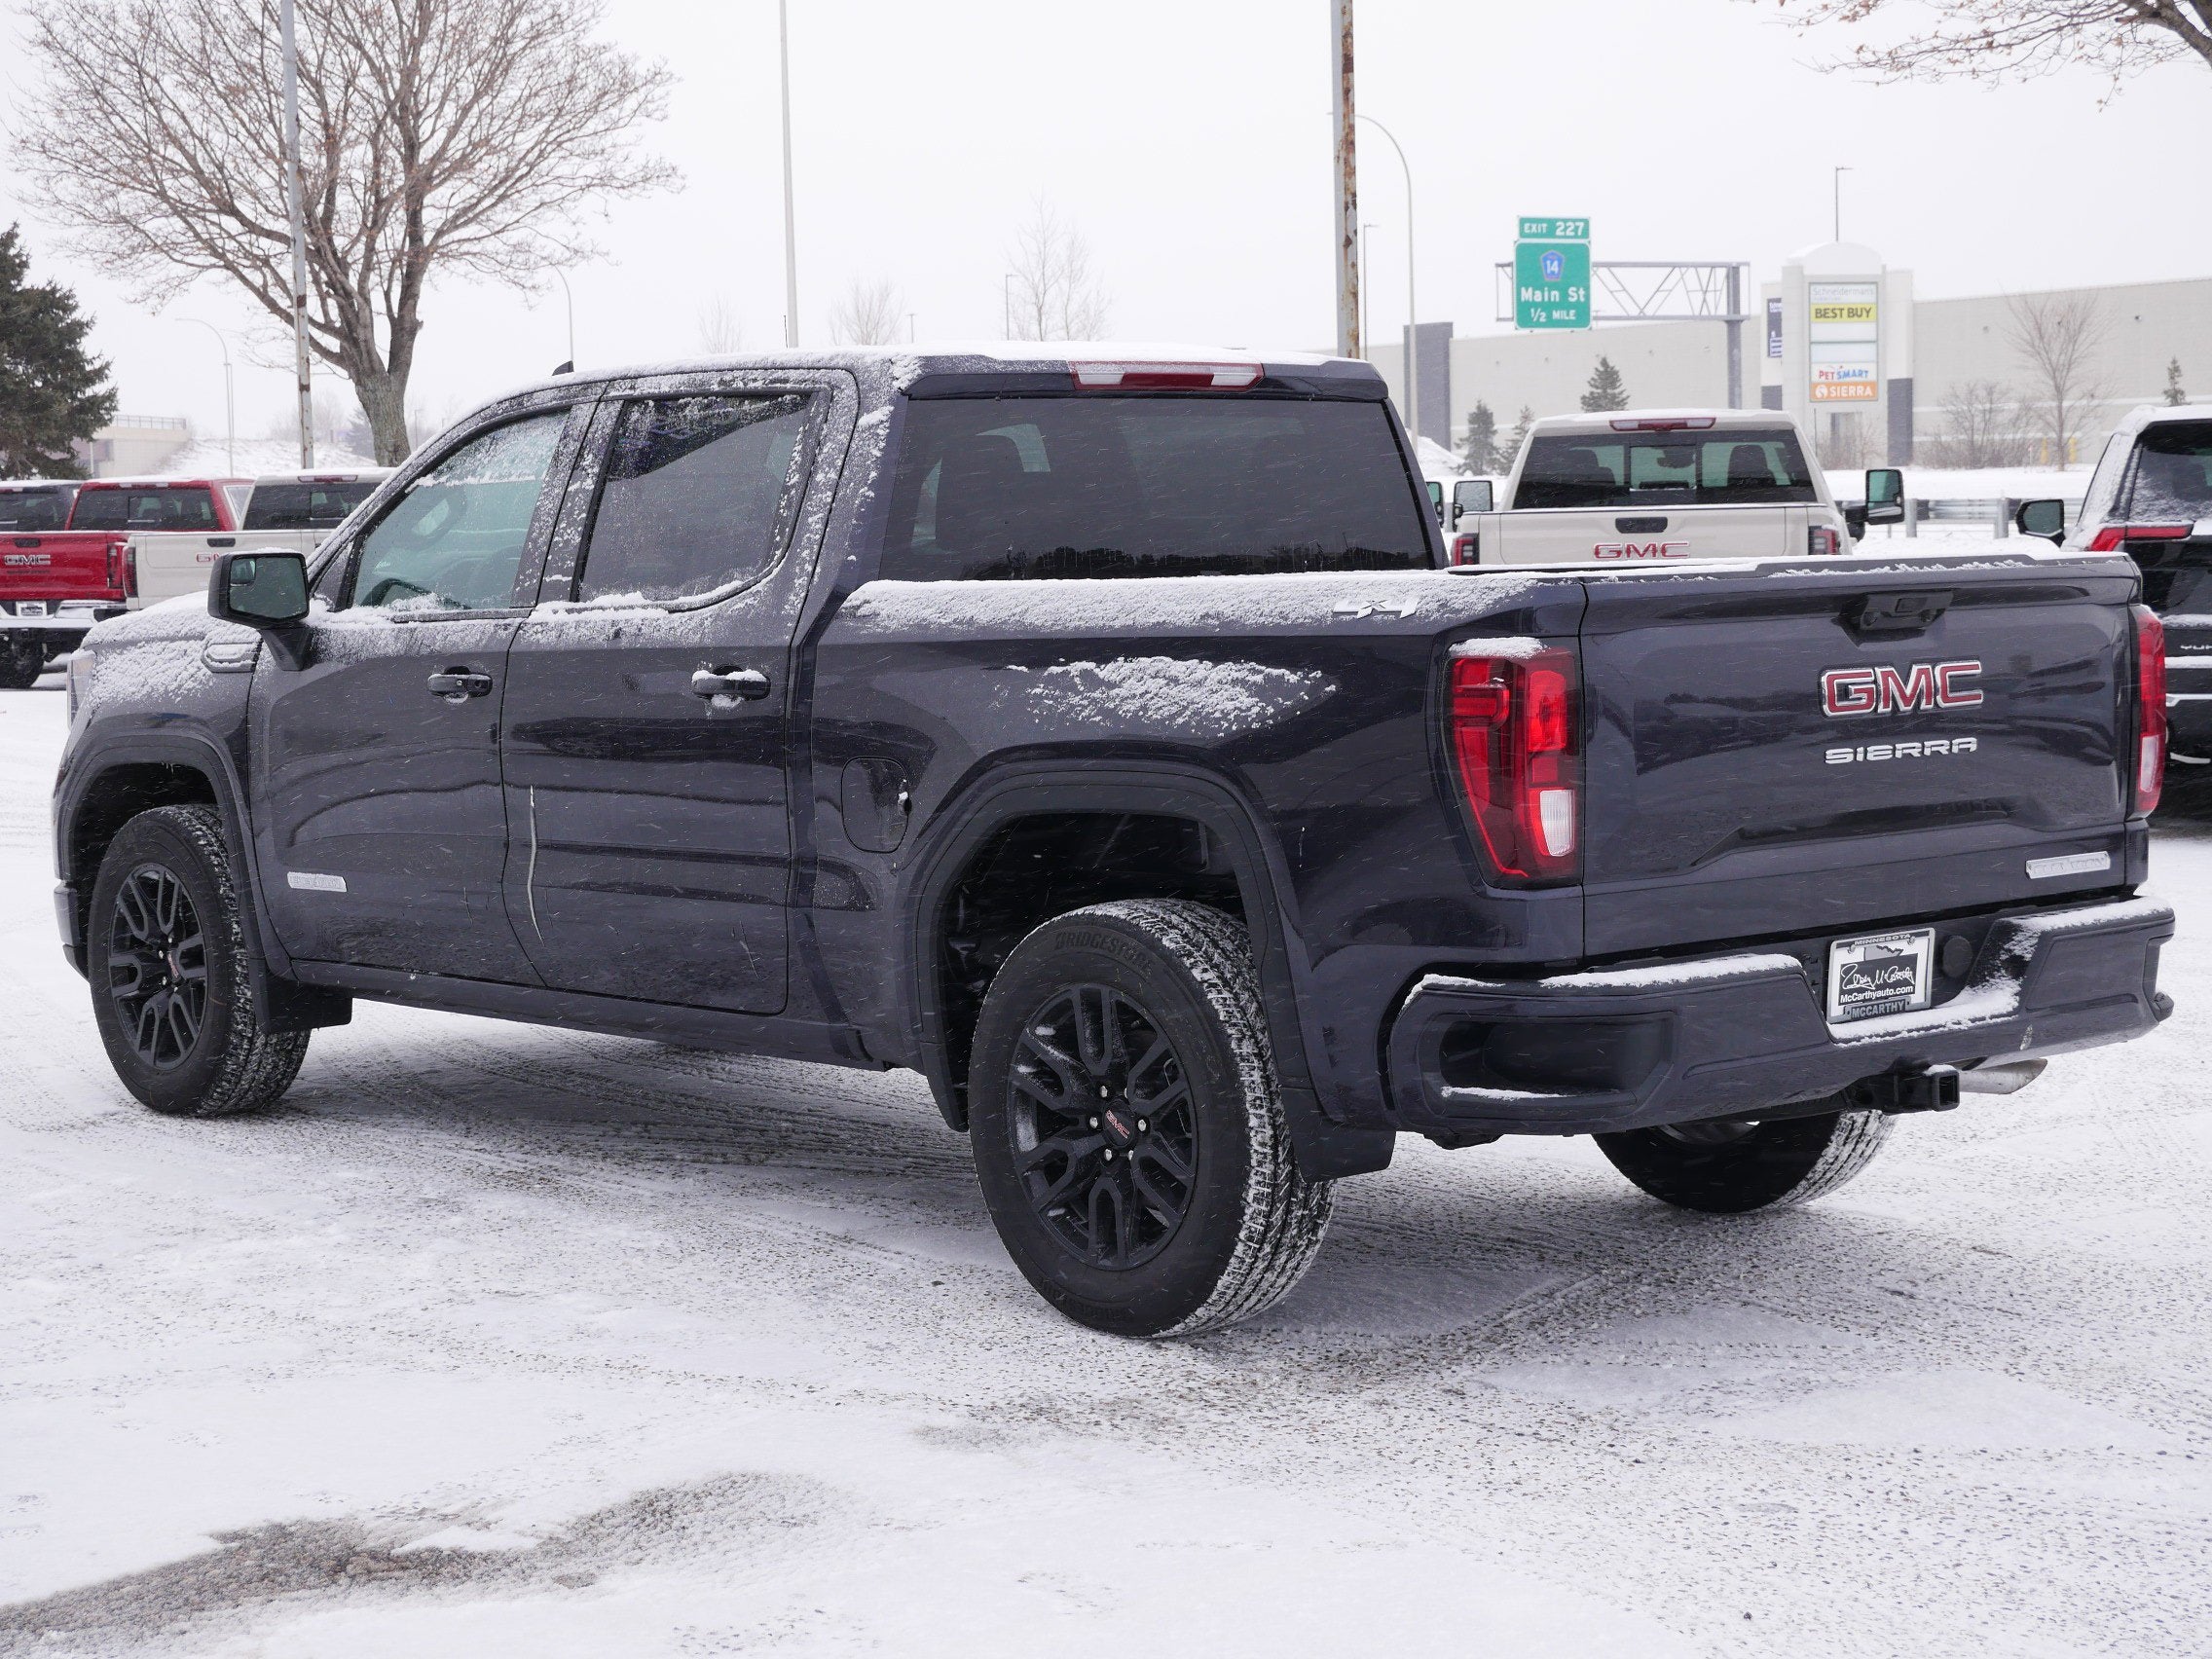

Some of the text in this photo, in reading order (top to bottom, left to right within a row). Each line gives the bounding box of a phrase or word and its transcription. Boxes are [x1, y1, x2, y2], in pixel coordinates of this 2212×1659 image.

[1524, 222, 1585, 236] EXIT 227
[1546, 260, 1560, 275] 14
[1521, 286, 1585, 302] Main St
[1552, 310, 1576, 320] MILE
[1815, 307, 1872, 319] BEST BUY
[1829, 385, 1873, 397] SIERRA
[1594, 541, 1689, 559] GMC
[4, 554, 51, 566] GMC
[1822, 660, 1984, 718] GMC
[1825, 737, 1977, 764] SIERRA
[1854, 934, 1911, 946] MINNESOTA
[1840, 985, 1914, 1004] McCarthyauto.com
[1852, 1000, 1905, 1019] MCCARTHY
[1106, 1110, 1130, 1139] GMC
